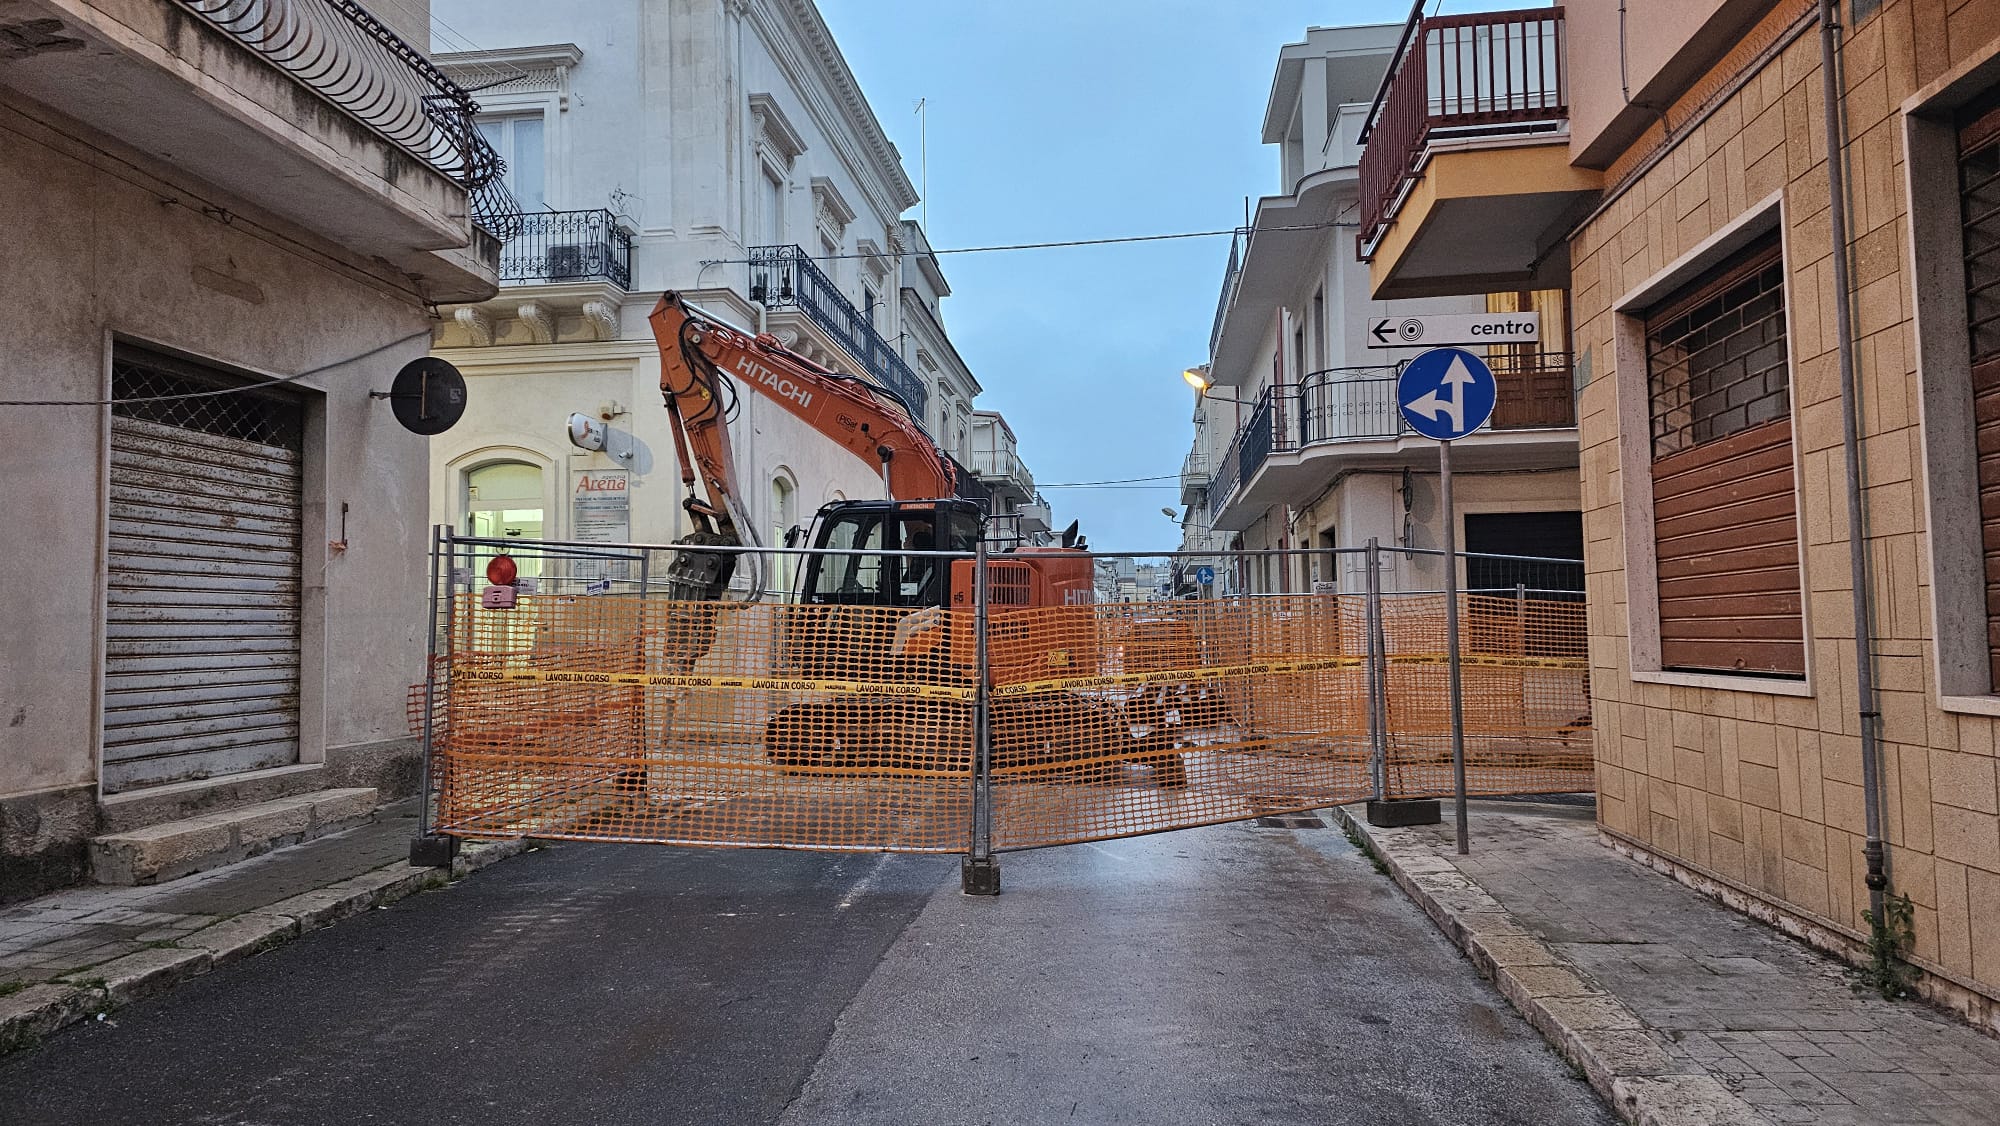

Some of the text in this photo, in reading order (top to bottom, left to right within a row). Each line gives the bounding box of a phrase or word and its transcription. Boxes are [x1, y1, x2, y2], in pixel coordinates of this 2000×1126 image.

[1470, 320, 1534, 335] centro
[736, 356, 813, 408] HITACHI
[576, 475, 626, 493] Arena
[1064, 589, 1093, 606] HITA
[467, 671, 476, 679] IN
[480, 671, 503, 680] CORSO
[546, 673, 572, 682] LAVORI
[574, 674, 582, 682] IN
[584, 674, 609, 683] CORSO
[649, 676, 675, 685] LAVORI
[677, 677, 686, 686] IN
[687, 678, 712, 687] CORSO
[752, 680, 778, 689] LAVORI
[781, 681, 789, 690] IN
[791, 681, 815, 690] CORSO
[856, 684, 882, 693] LAVORI
[885, 685, 893, 693] IN
[895, 686, 920, 694] CORSO
[996, 687, 1004, 696] IN
[1005, 685, 1027, 694] CORSO
[1061, 679, 1084, 688] LAVORI
[1085, 679, 1093, 687] IN
[1093, 677, 1115, 686] CORSO
[1146, 673, 1168, 682] LAVORI
[1168, 673, 1175, 681] IN
[1177, 671, 1196, 680] CORSO
[1224, 668, 1244, 676] LAVORI
[1244, 667, 1251, 675] IN
[1251, 665, 1269, 674] CORSO
